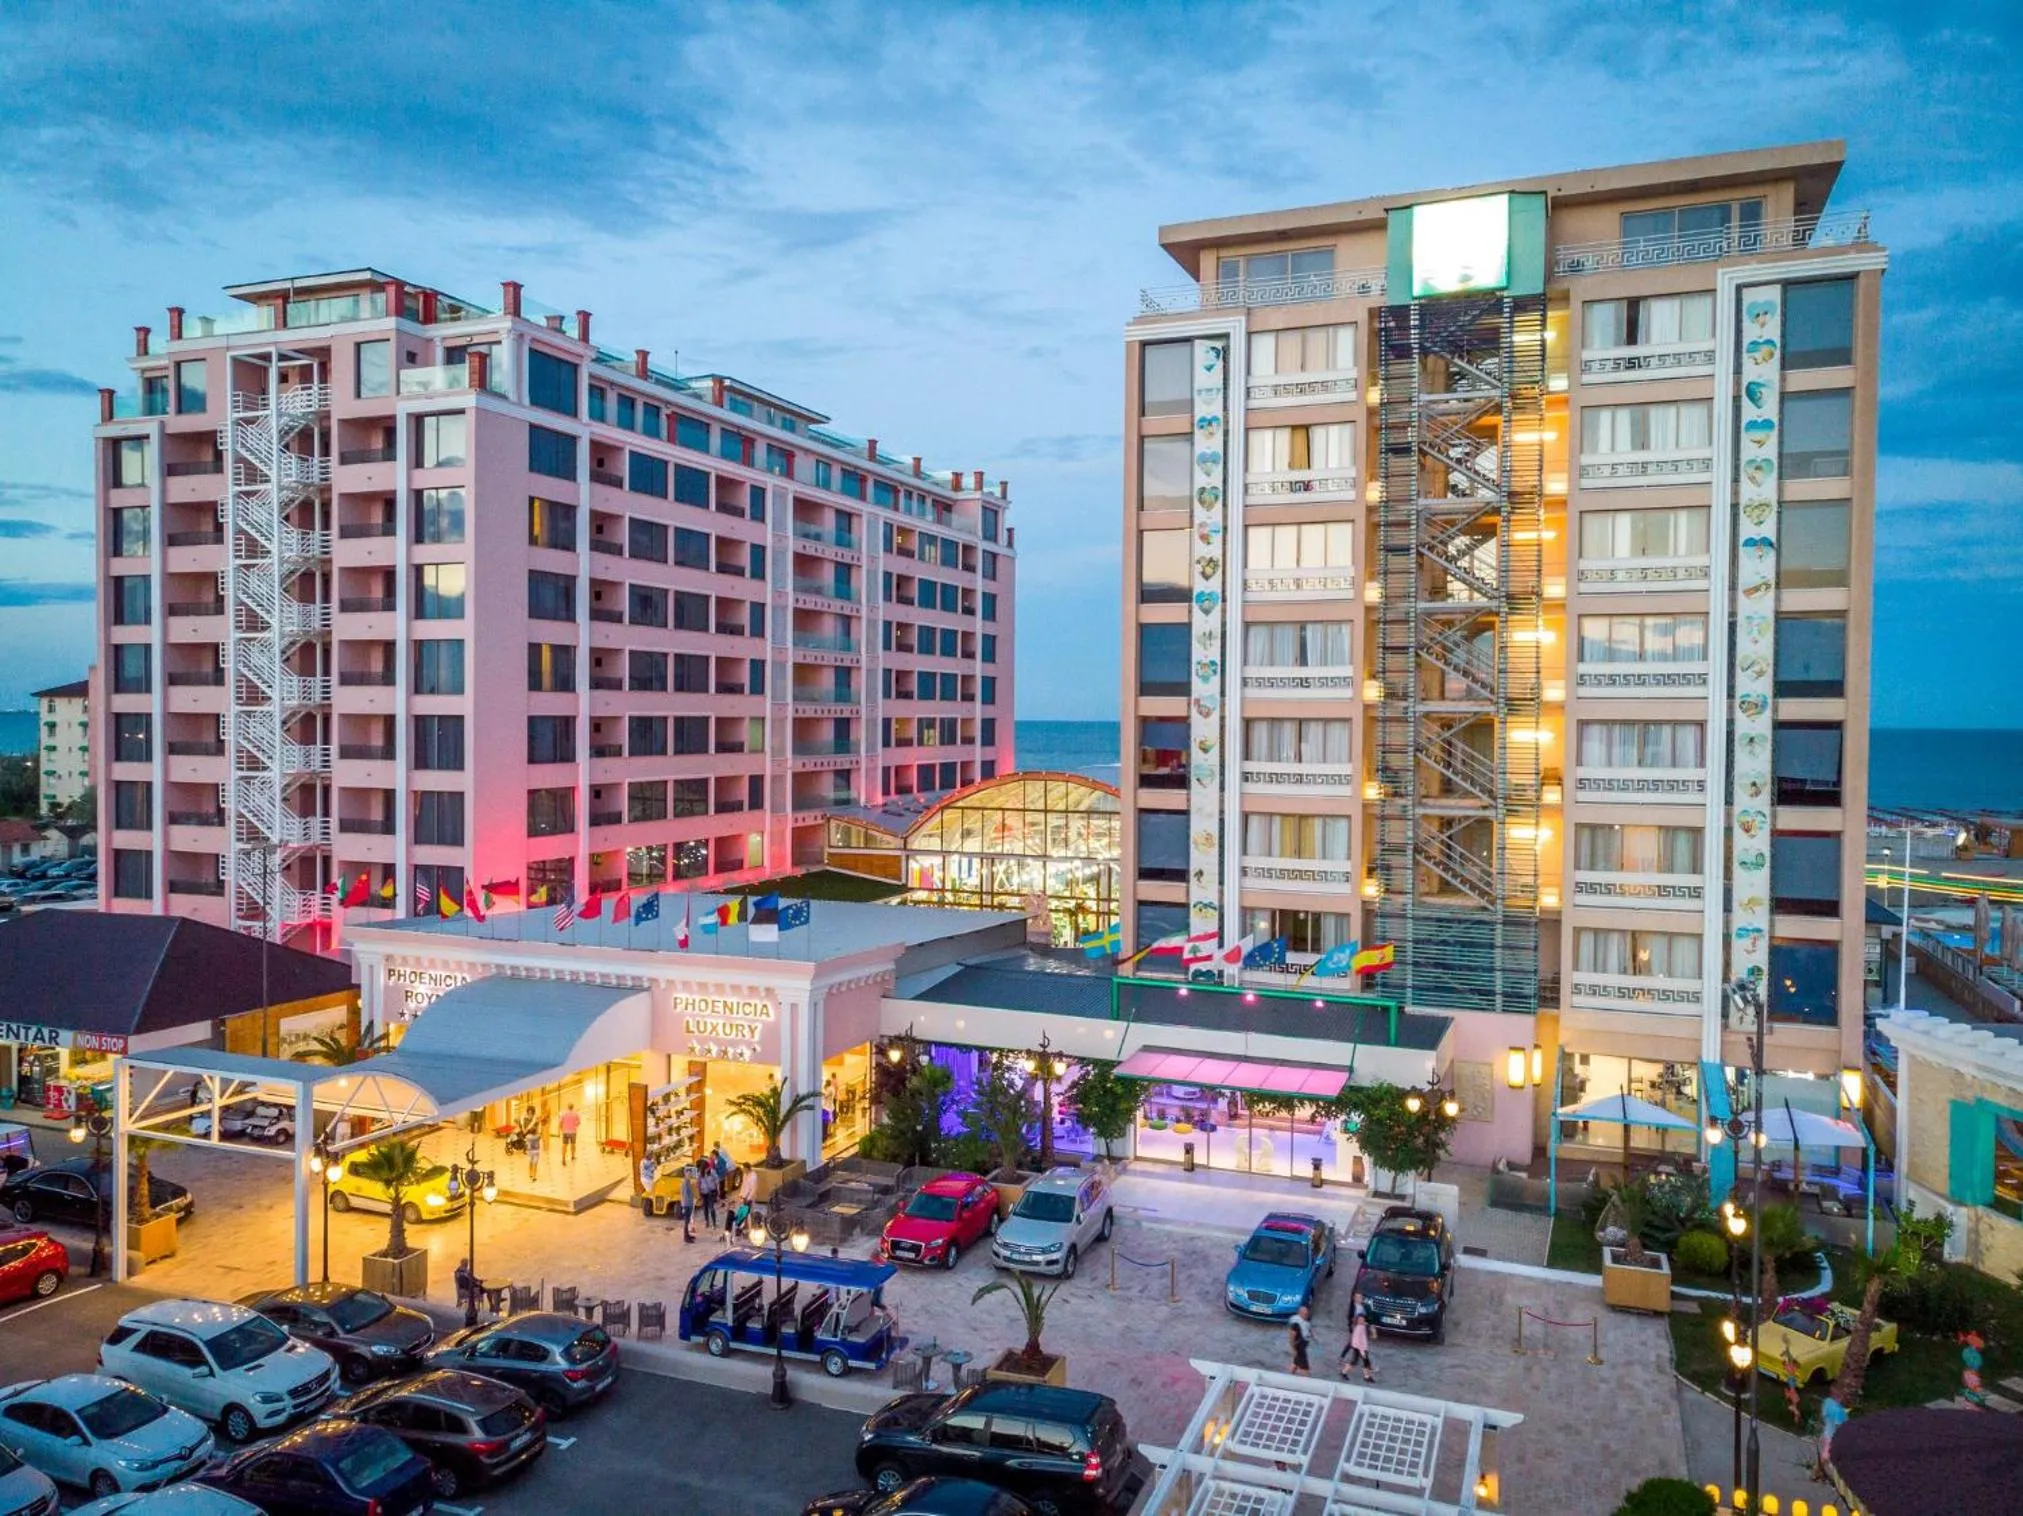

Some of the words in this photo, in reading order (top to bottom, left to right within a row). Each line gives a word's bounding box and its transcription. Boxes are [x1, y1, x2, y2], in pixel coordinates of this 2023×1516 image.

[387, 968, 468, 987] PHOENICIA
[404, 989, 442, 1005] ROY
[673, 996, 771, 1017] PHOENICIA
[685, 1019, 759, 1039] LUXURY
[77, 1034, 99, 1048] NON
[101, 1036, 124, 1051] STOP
